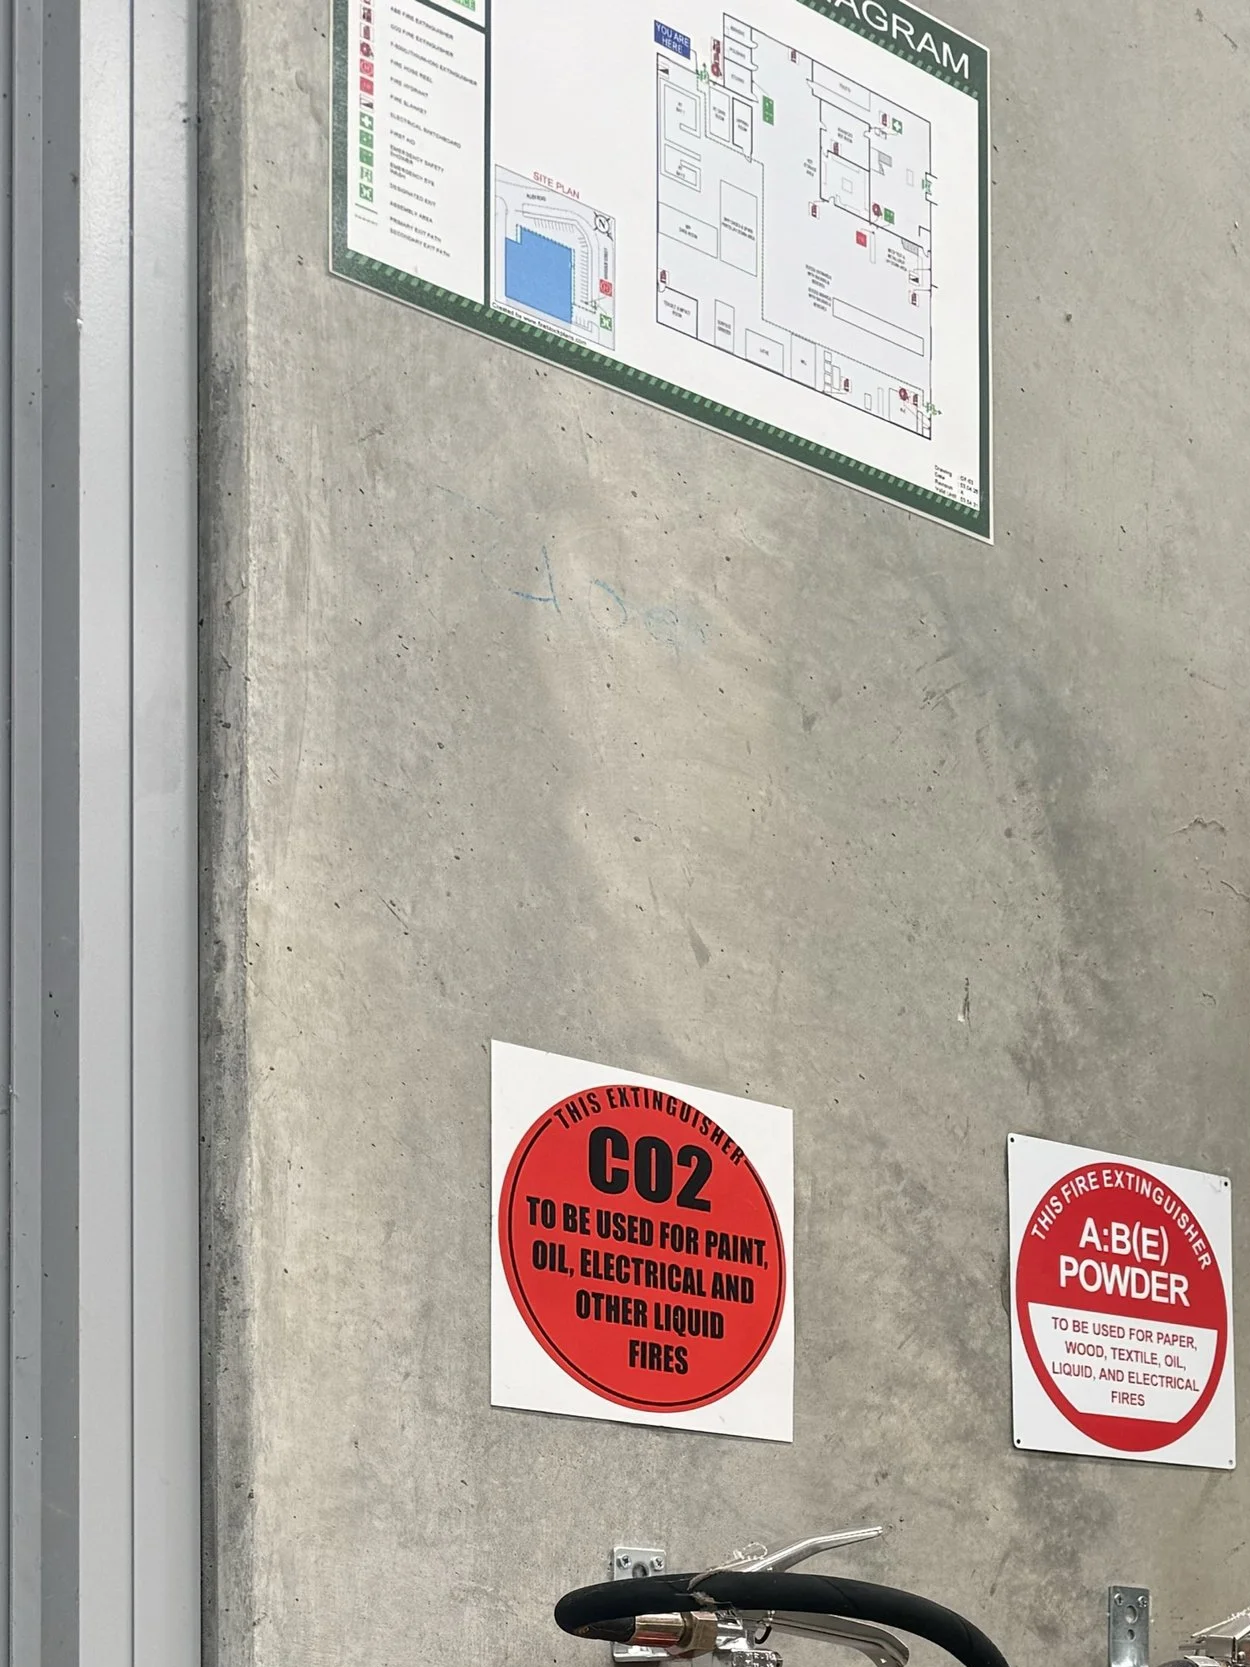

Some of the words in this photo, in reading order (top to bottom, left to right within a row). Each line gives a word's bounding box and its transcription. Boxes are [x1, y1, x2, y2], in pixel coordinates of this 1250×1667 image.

[402, 11, 414, 21] FIRE
[415, 18, 454, 40] EXTINGUISHER
[655, 22, 673, 36] YOU
[673, 32, 689, 48] ARE
[827, 0, 969, 79] AGRAM
[662, 38, 683, 54] HERE
[390, 129, 405, 141] FIRST
[533, 171, 554, 188] SITE
[556, 181, 580, 200] PLAN
[390, 200, 418, 217] ASSEMBLY
[390, 216, 414, 231] PRIMARY
[415, 226, 426, 237] EXIT
[390, 228, 422, 247] SECONDARY
[423, 242, 435, 252] EXIT
[491, 302, 514, 316] Created
[553, 1092, 601, 1129] THIS
[605, 1087, 745, 1167] EXTINGUISHER
[588, 1126, 713, 1213] CO2
[526, 1196, 556, 1229] TO
[562, 1203, 591, 1235] BE
[596, 1209, 653, 1247] USED
[659, 1222, 699, 1255] FOR
[705, 1230, 768, 1270] PAINT,
[1031, 1196, 1064, 1240] THIS
[1060, 1171, 1099, 1203] FIRE
[1102, 1169, 1212, 1271] EXTINGUISHER
[1079, 1216, 1169, 1266] A:B(E)
[532, 1240, 575, 1278] OIL,
[580, 1247, 707, 1297] ELECTRICAL
[711, 1271, 754, 1304] AND
[1059, 1254, 1190, 1307] POWDER
[575, 1289, 648, 1328] OTHER
[653, 1302, 724, 1339] LIQUID
[1051, 1316, 1069, 1331] TO
[1072, 1320, 1089, 1334] BE
[1092, 1323, 1126, 1339] USED
[1129, 1328, 1153, 1343] FOR
[1156, 1331, 1198, 1351] PAPER,
[629, 1339, 689, 1375] FIRES
[1065, 1341, 1108, 1360] WOOD,
[1111, 1347, 1161, 1368] TEXTILE,
[1164, 1354, 1187, 1371] OIL,
[1052, 1362, 1096, 1381] LIQUID,
[1099, 1367, 1125, 1382] AND
[1128, 1371, 1200, 1392] ELECTRICAL
[1111, 1390, 1146, 1407] FIRES
